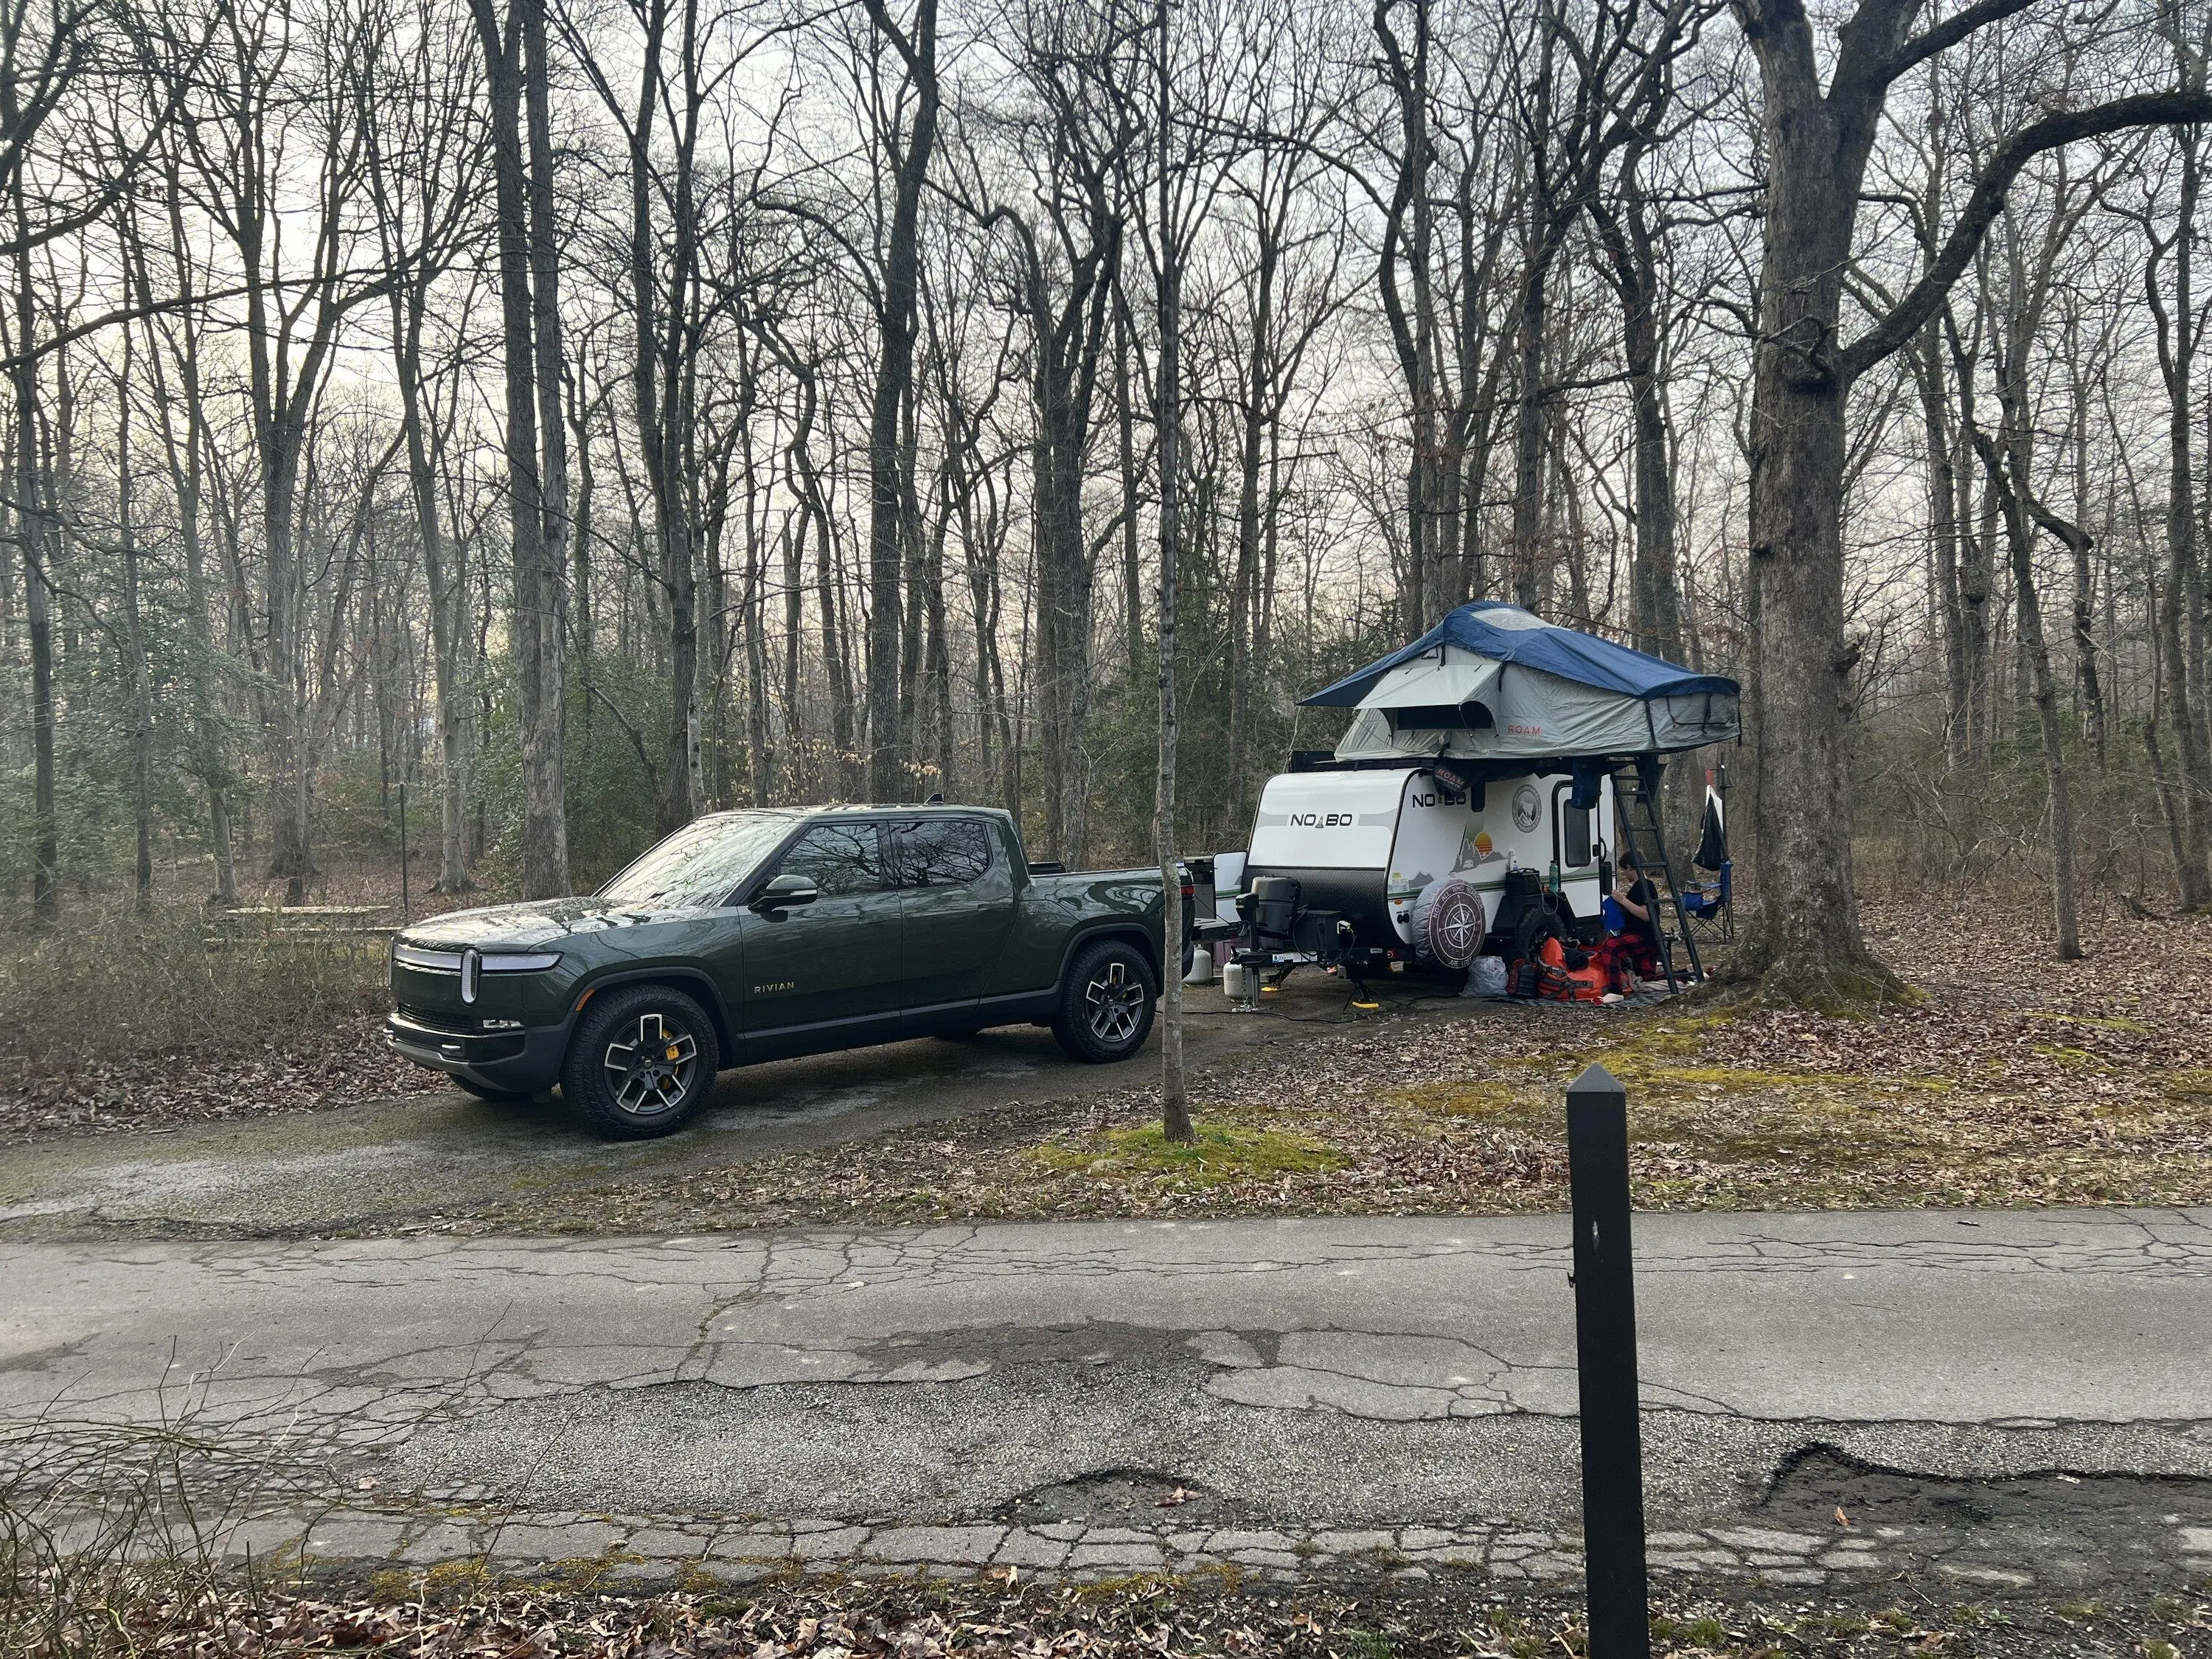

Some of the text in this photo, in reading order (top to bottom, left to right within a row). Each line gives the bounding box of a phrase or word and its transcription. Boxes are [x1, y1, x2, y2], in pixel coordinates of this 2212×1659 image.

[1508, 726, 1541, 734] ROAM
[1436, 769, 1464, 786] ROAM
[1433, 903, 1441, 919] NOT
[1441, 890, 1450, 902] ALL
[754, 981, 794, 994] RIVIAN
